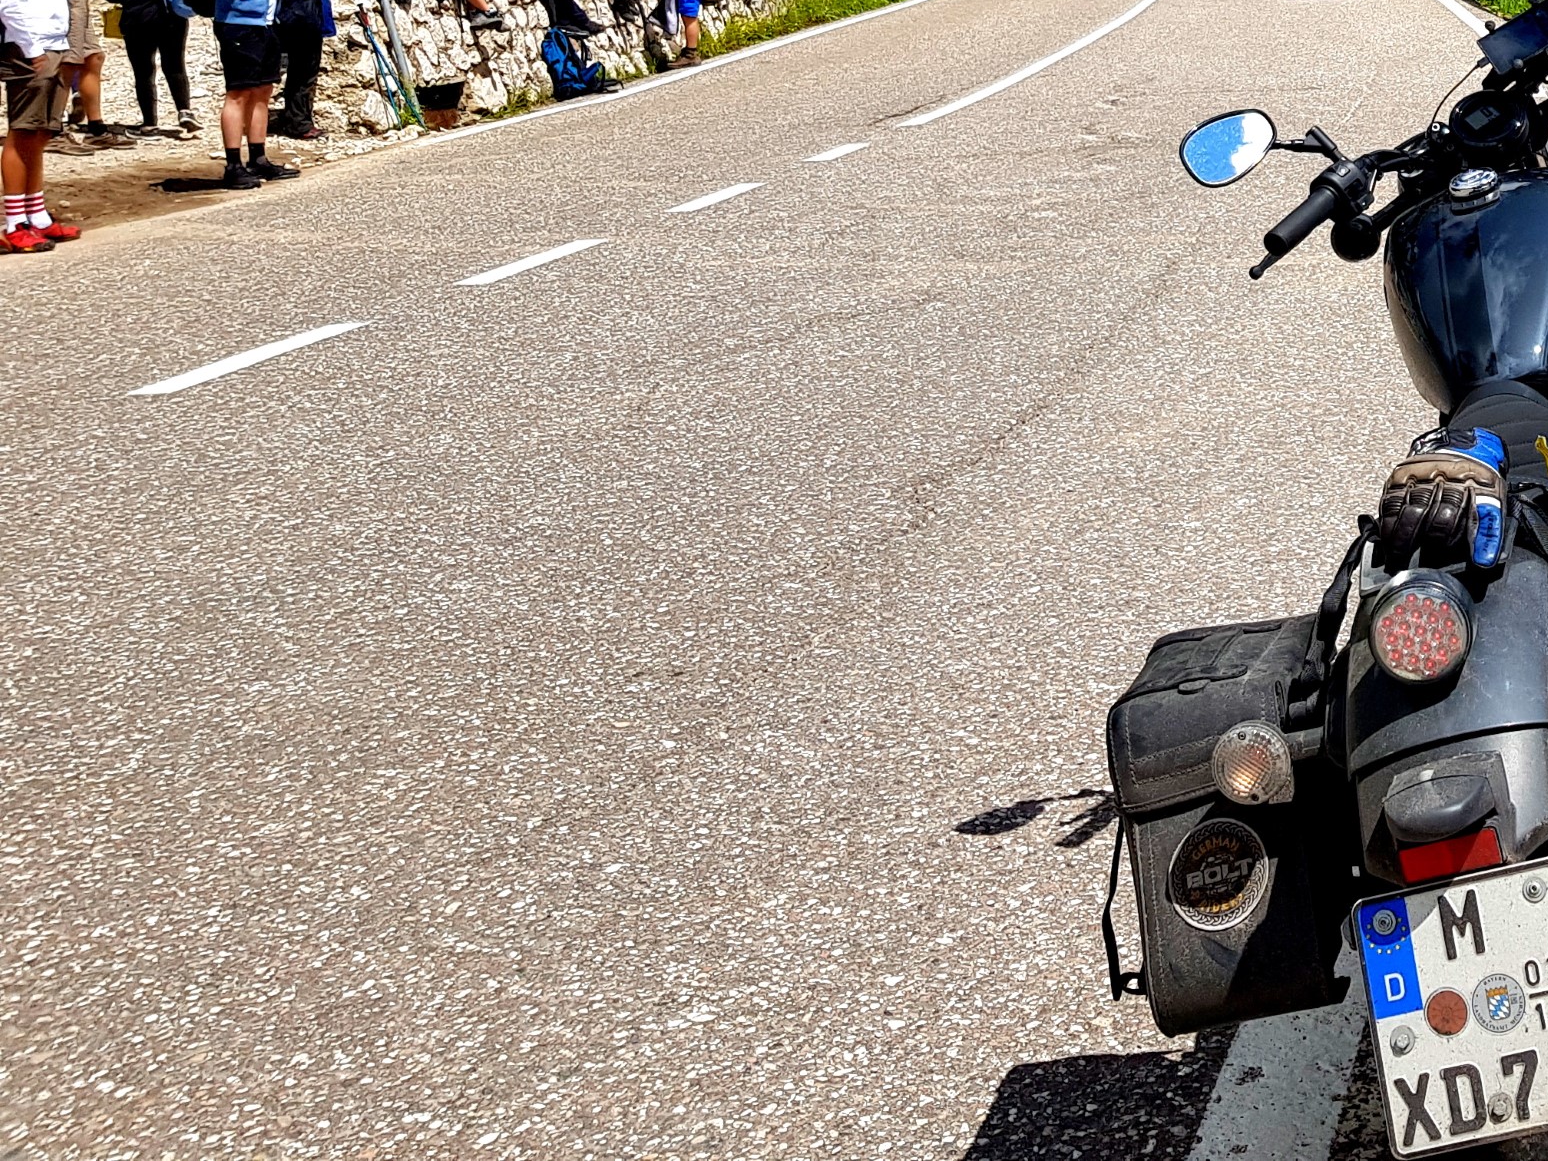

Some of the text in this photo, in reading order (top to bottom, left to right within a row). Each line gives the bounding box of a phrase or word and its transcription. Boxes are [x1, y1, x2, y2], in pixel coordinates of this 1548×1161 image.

[1185, 857, 1253, 889] BOLT
[1437, 889, 1486, 960] M
[1383, 972, 1406, 1002] D
